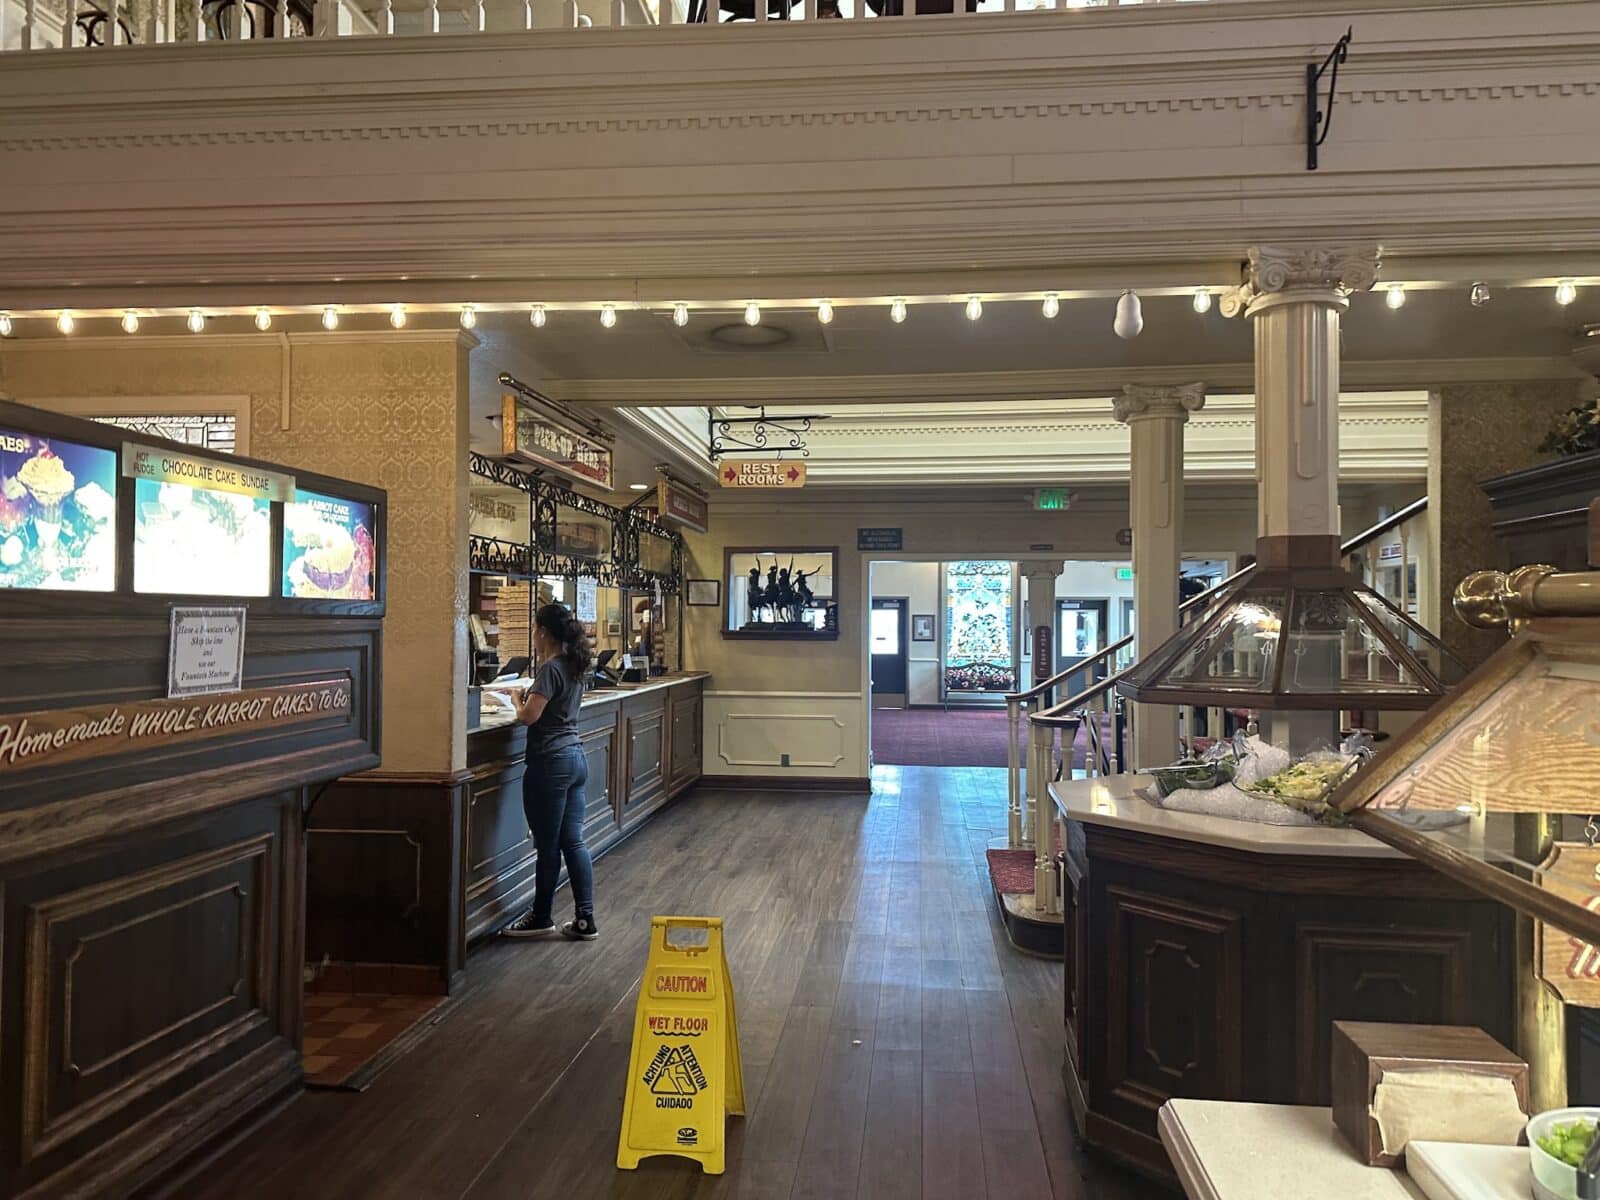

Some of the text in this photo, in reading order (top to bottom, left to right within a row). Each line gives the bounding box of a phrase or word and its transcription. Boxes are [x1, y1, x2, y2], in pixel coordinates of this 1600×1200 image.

[136, 451, 149, 462] HOT
[134, 463, 155, 475] FUDGE
[161, 458, 269, 490] CHOCOLATE CAKE SUNDAE
[742, 463, 780, 474] REST
[738, 474, 785, 485] ROOMS
[181, 672, 208, 681] Fountain
[0, 687, 349, 764] Homemade WHOLE KARROT CAKES To Go
[655, 975, 707, 993] CAUTION
[648, 1016, 709, 1032] WET FLOOR
[642, 1044, 671, 1086] ACHTUNG
[680, 1044, 708, 1090] ATTENTION
[655, 1097, 693, 1110] CUIDADO
